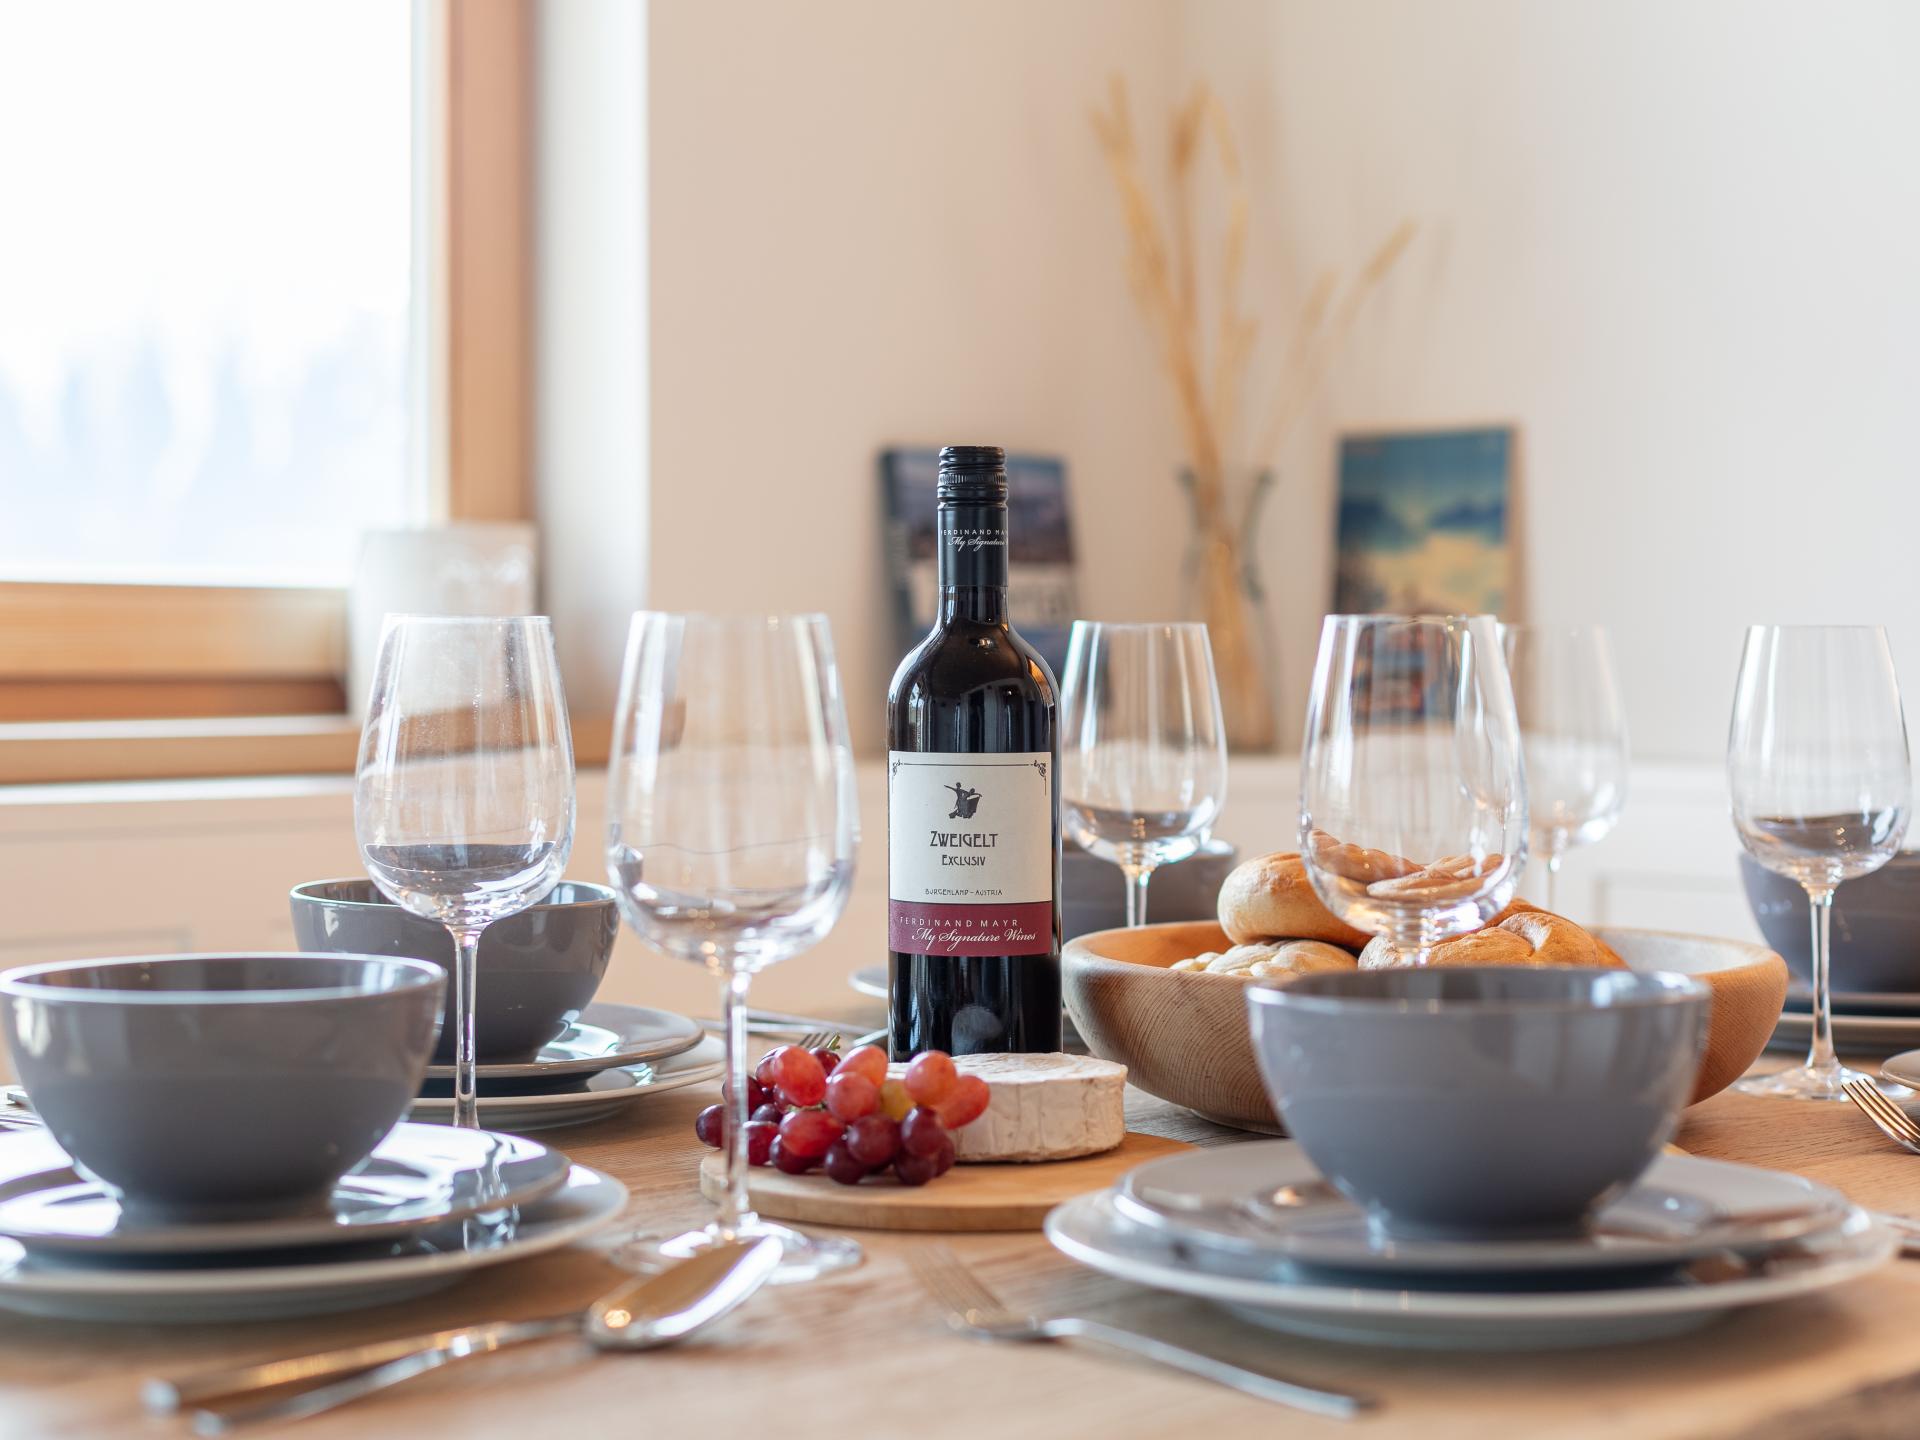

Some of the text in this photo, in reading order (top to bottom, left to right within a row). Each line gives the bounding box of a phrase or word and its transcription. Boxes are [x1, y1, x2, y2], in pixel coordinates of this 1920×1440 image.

[948, 536, 966, 552] My
[930, 831, 998, 848] ZWEIGELT
[942, 855, 986, 866] EXCLUSIV
[900, 916, 1019, 928] FERDINAND MAYR
[911, 928, 1036, 952] My Signature Wines
